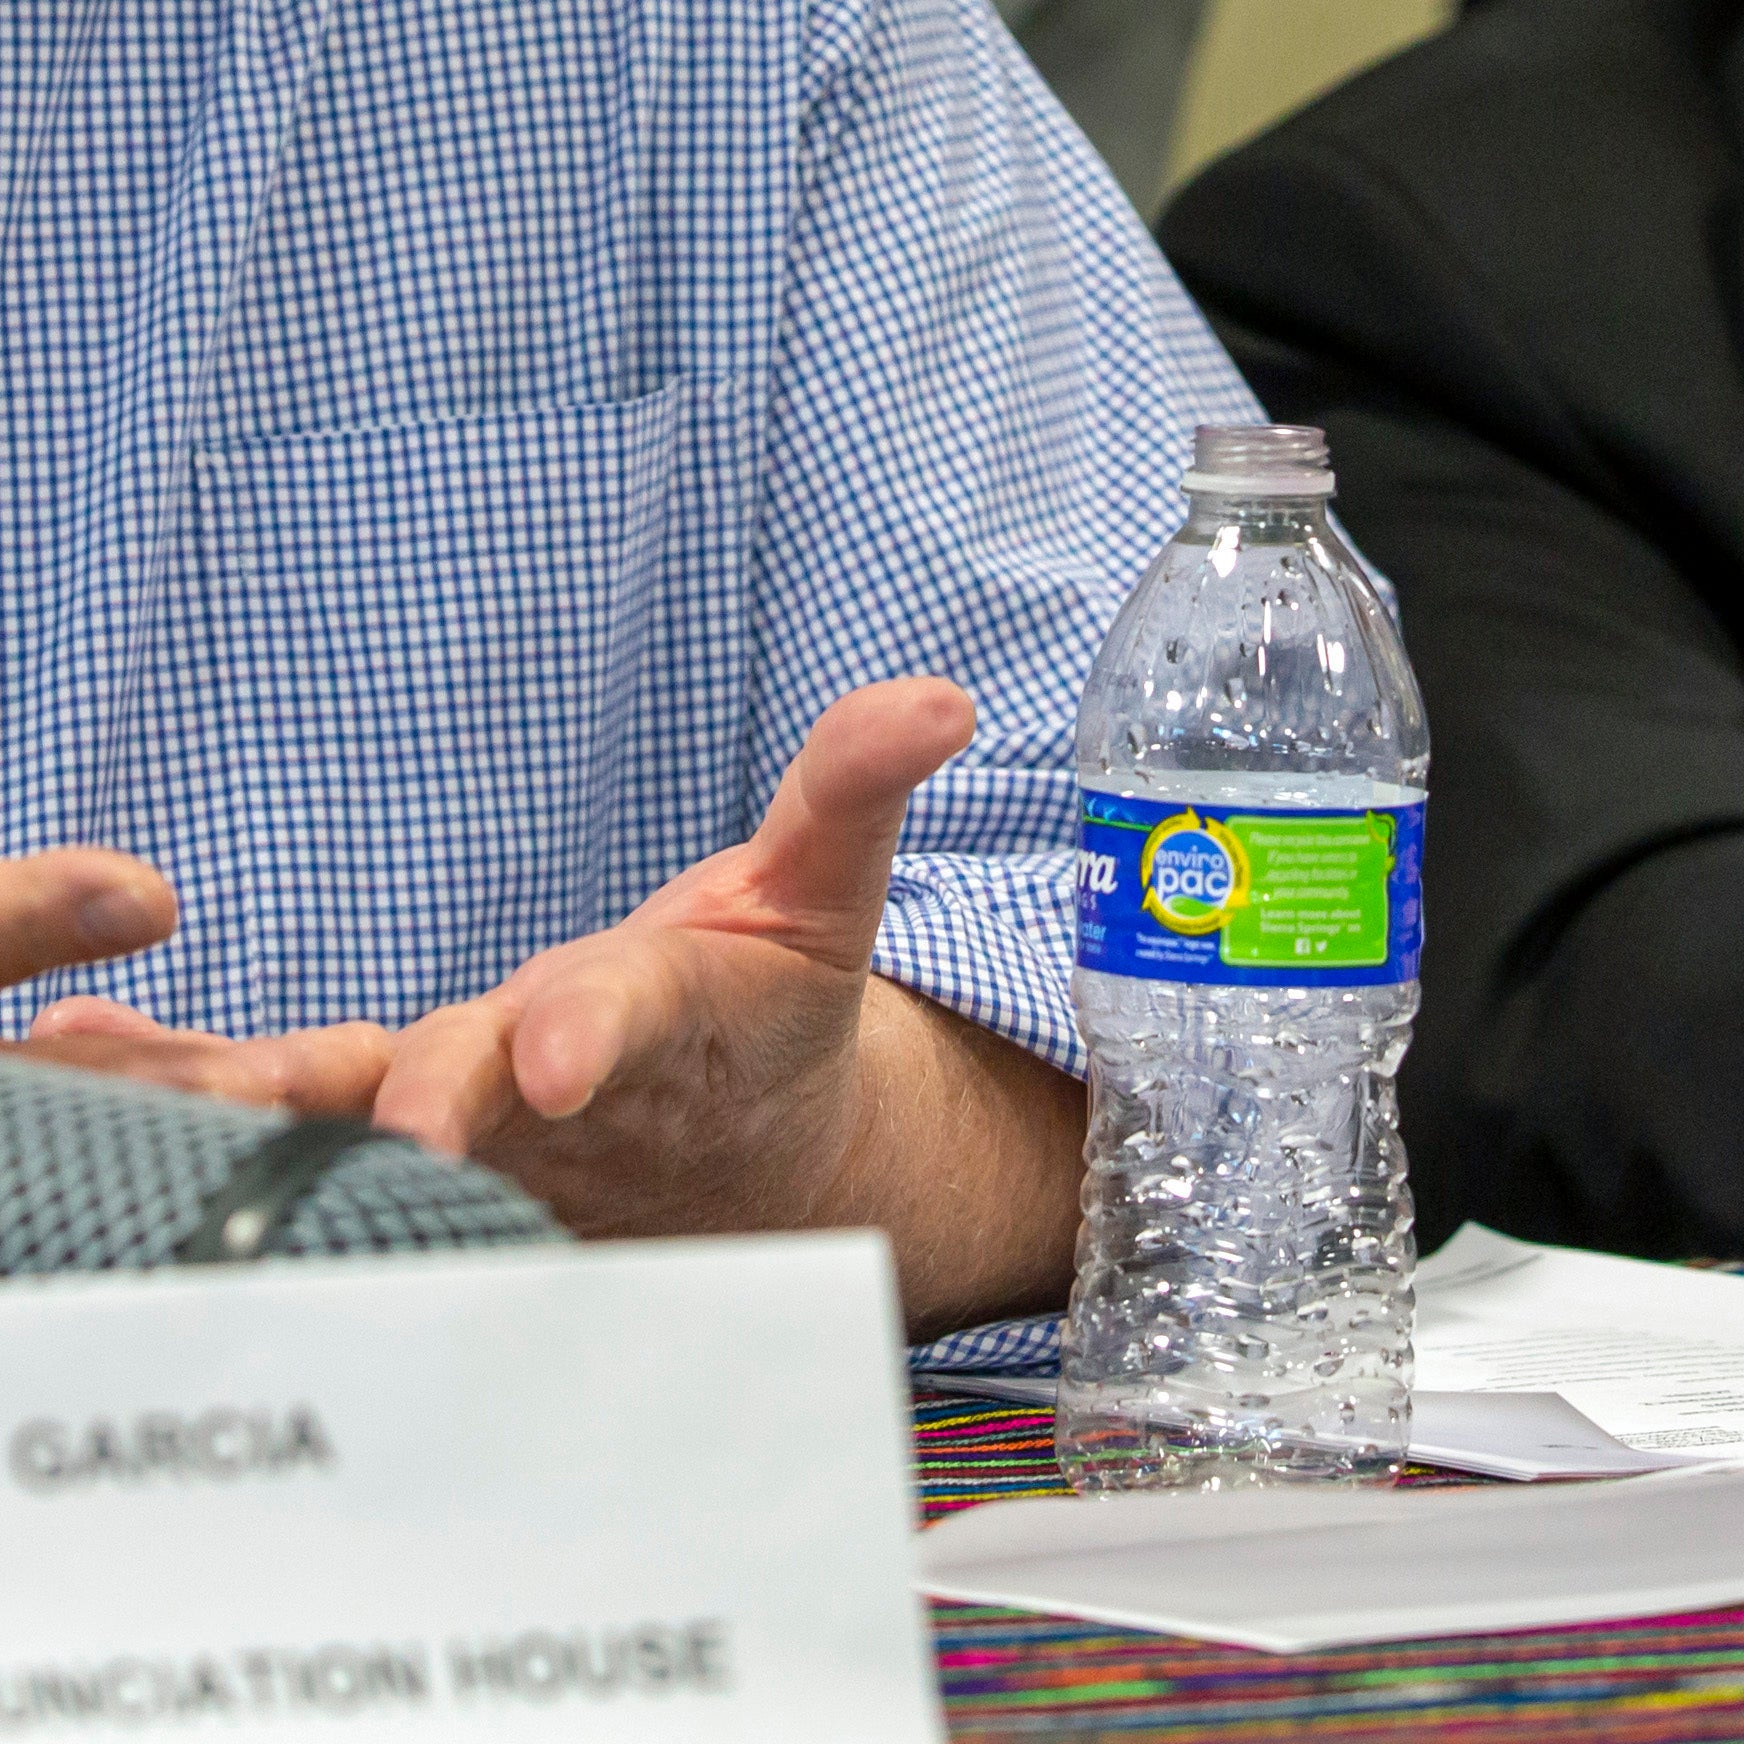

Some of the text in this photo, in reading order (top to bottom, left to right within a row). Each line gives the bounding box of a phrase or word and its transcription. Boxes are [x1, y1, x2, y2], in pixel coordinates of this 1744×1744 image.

[1156, 845, 1225, 869] enviro
[1158, 867, 1228, 902] pac
[9, 1404, 336, 1494] GARCIA
[444, 1616, 734, 1703] HOUSE
